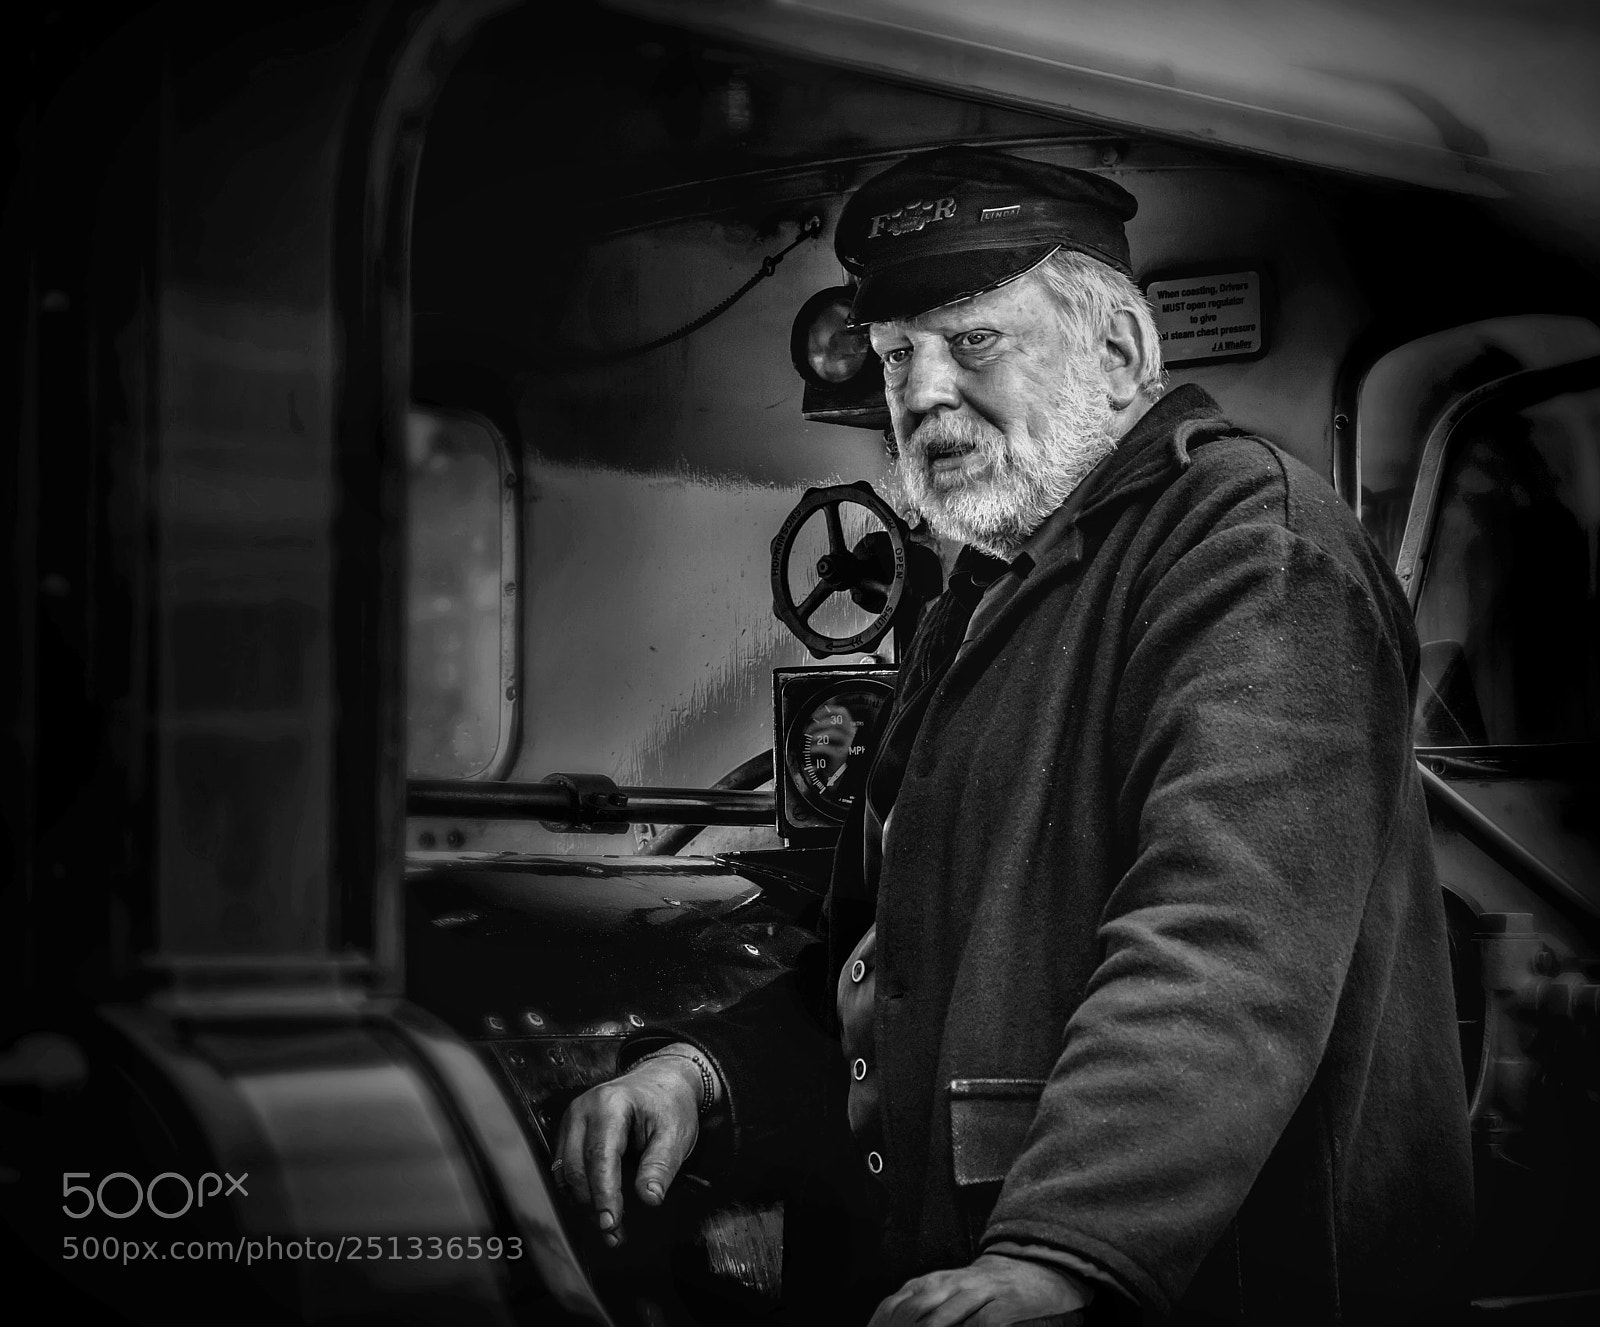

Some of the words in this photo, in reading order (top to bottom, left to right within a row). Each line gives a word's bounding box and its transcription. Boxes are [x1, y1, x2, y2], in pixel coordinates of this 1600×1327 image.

[984, 210, 1016, 220] LINDA
[1157, 290, 1179, 299] When
[1181, 286, 1218, 297] coasting,
[1219, 282, 1249, 292] Drivers
[1162, 302, 1185, 313] MUST
[1186, 300, 1207, 312] open
[1208, 297, 1245, 309] regulator
[1189, 315, 1198, 324] to
[1200, 313, 1217, 325] give
[1170, 330, 1195, 340] steam
[1196, 327, 1219, 337] chest
[1220, 324, 1256, 336] pressure
[771, 507, 802, 576] HOPKINSONS
[895, 547, 904, 579] OPEN
[874, 605, 894, 631] SHUT
[830, 714, 843, 725] 30
[816, 735, 830, 745] 20
[816, 758, 827, 769] 10
